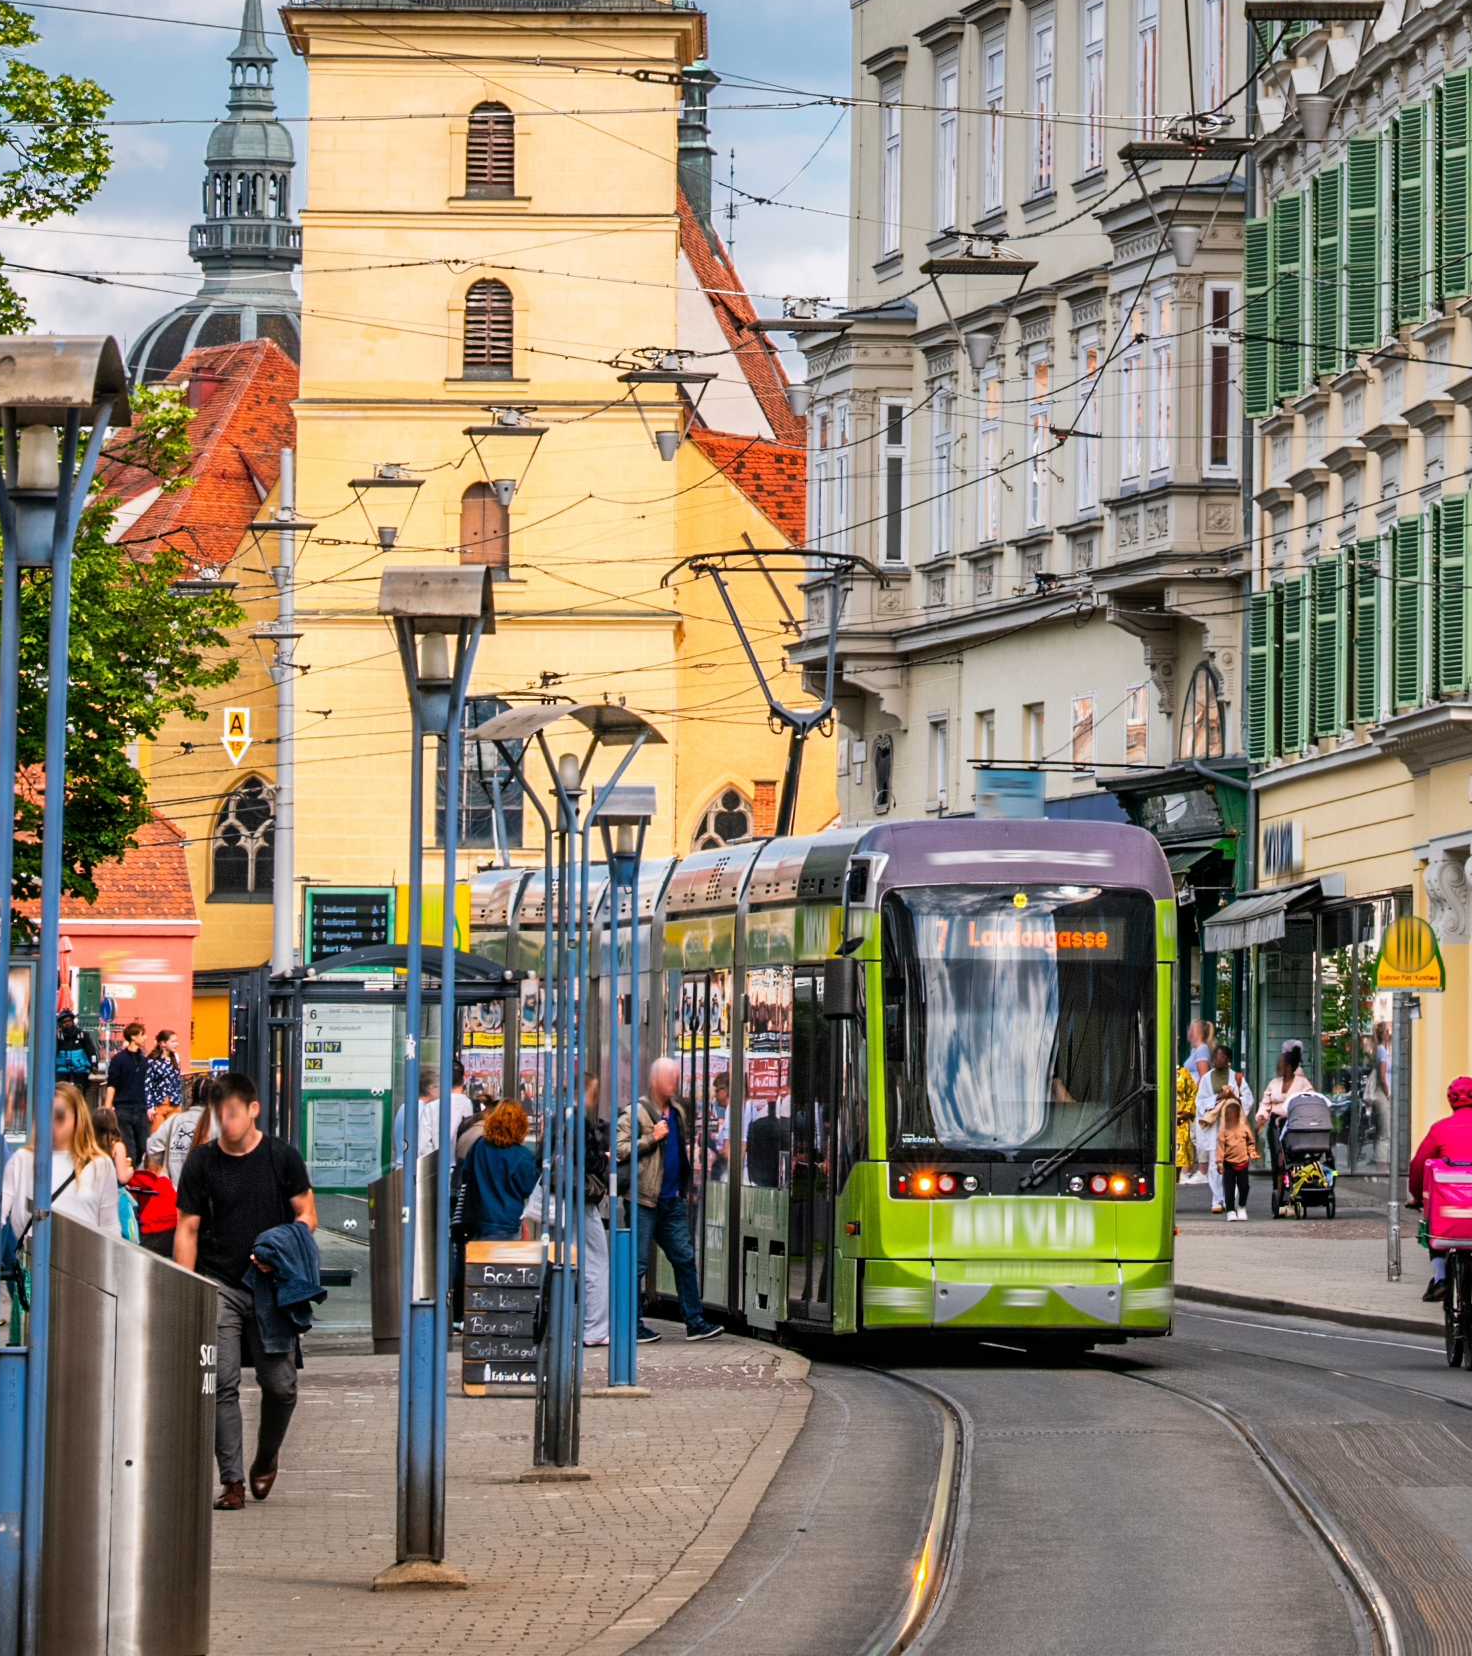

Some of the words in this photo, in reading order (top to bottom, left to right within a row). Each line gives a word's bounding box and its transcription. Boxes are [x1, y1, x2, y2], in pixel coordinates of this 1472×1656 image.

[229, 713, 243, 734] A
[936, 920, 949, 952] 7
[968, 920, 1109, 953] Laudongasse
[310, 1009, 317, 1020] 6
[316, 1026, 323, 1037] 7
[306, 1043, 321, 1052] N1
[324, 1043, 340, 1052] N7
[306, 1059, 321, 1069] N2
[482, 1266, 513, 1284] Box
